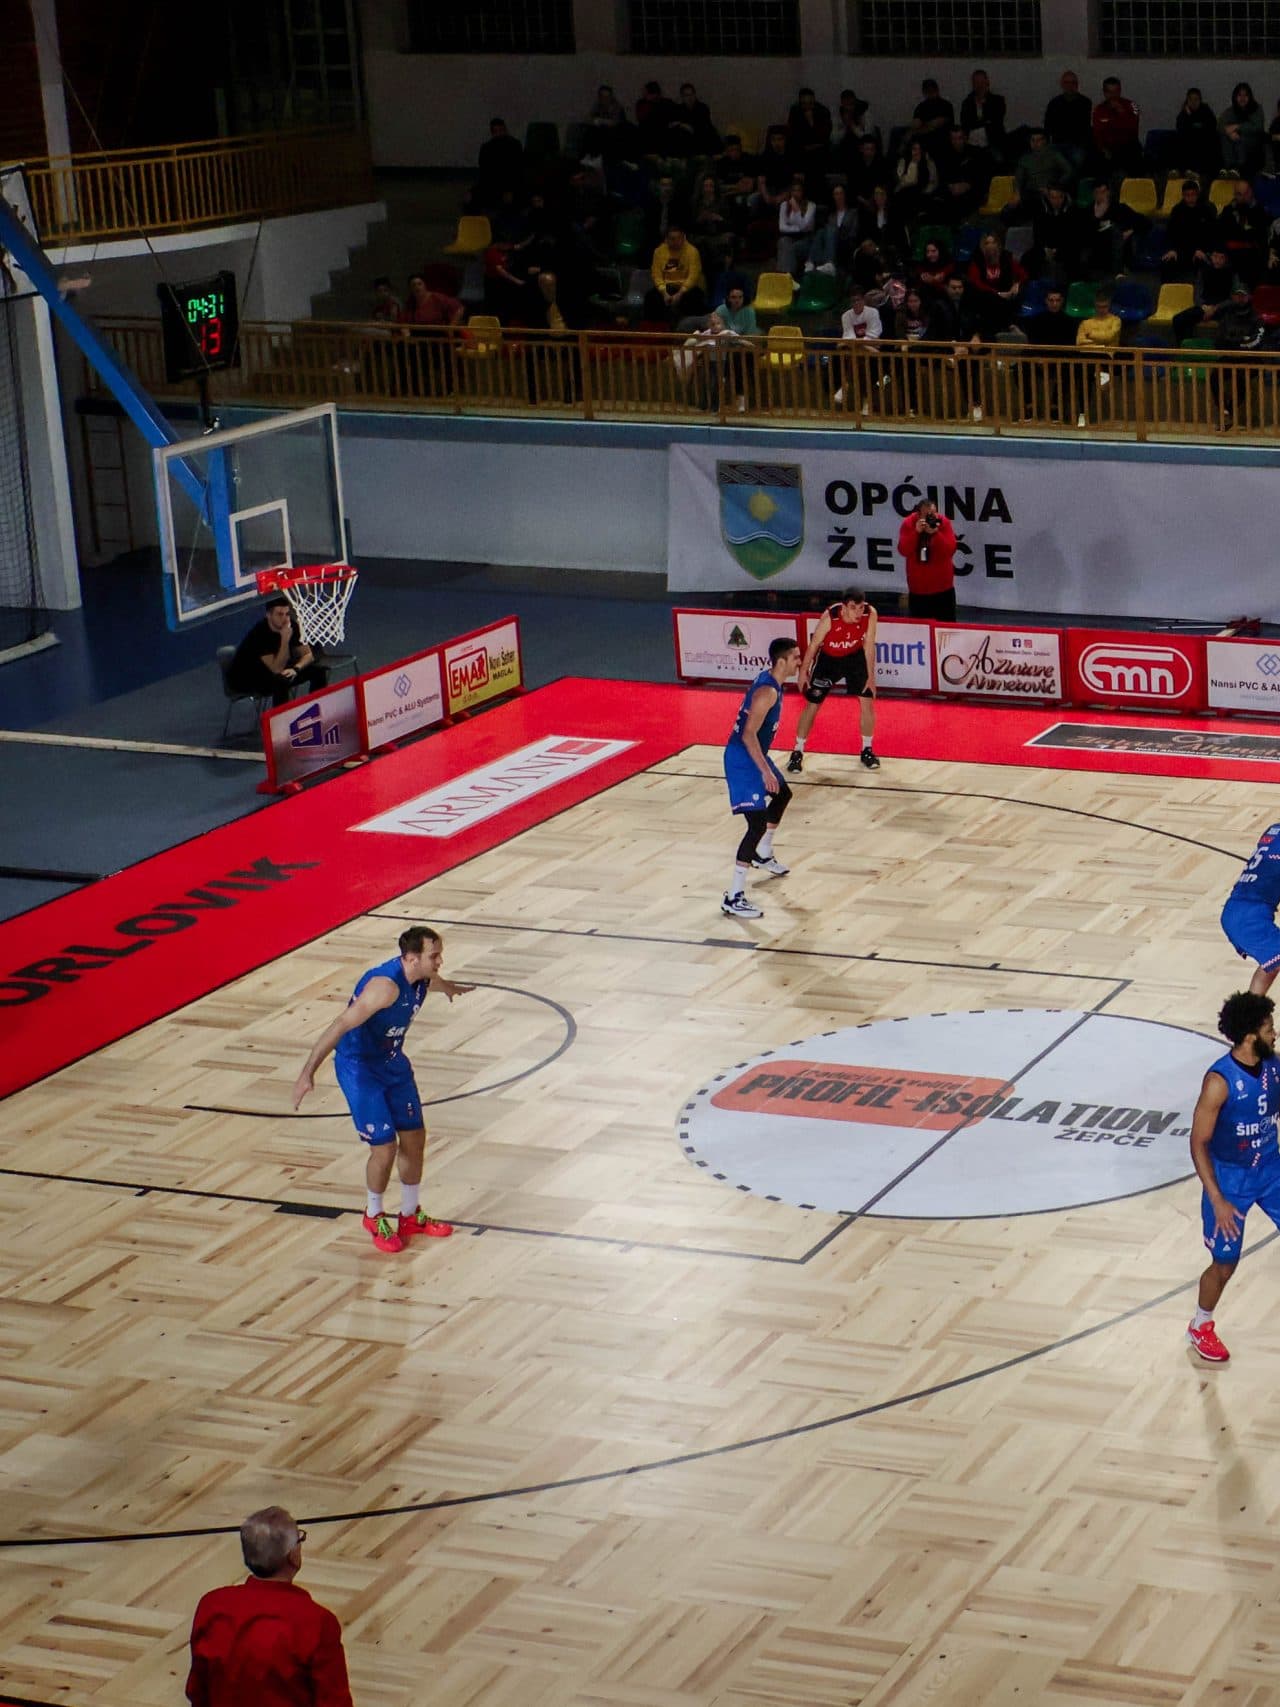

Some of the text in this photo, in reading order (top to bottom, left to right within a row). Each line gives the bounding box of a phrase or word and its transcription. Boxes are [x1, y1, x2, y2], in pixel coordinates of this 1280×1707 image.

[188, 293, 224, 323] 04:31
[201, 317, 222, 355] 13
[825, 475, 1012, 523] OPĆINA
[827, 527, 1014, 579] ŽEČE
[452, 654, 486, 690] EMAR
[1210, 679, 1237, 689] Nansi
[1239, 681, 1258, 691] PVC
[1261, 683, 1268, 691] &
[0, 856, 322, 1007] ORLOVIK
[1257, 1094, 1268, 1116] 5
[1054, 1127, 1156, 1148] ŽEPČE
